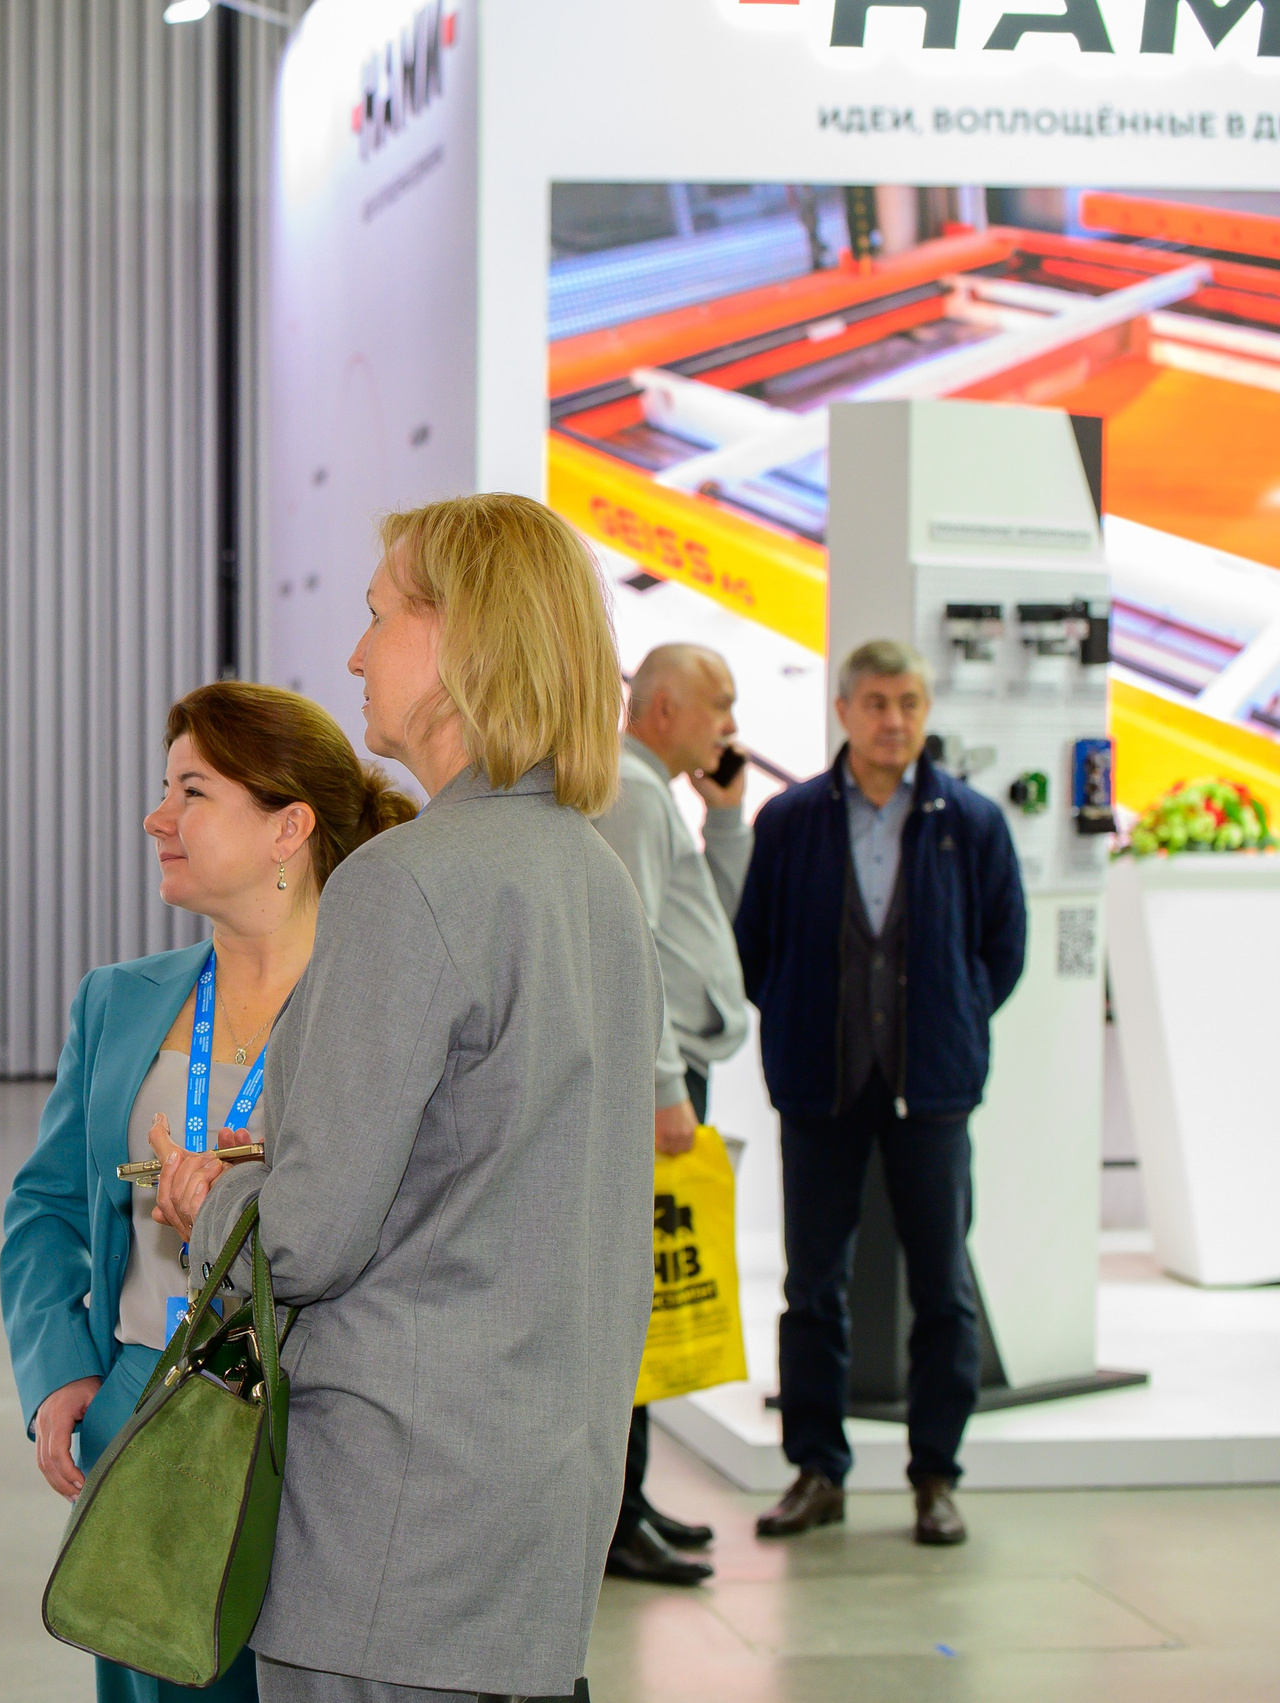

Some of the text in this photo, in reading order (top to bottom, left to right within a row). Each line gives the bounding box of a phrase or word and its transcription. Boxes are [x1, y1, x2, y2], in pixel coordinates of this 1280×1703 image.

[933, 104, 1216, 139] ВОПЛОЩЁННЫЕ
[1227, 111, 1245, 138] В
[589, 496, 715, 585] GEISS
